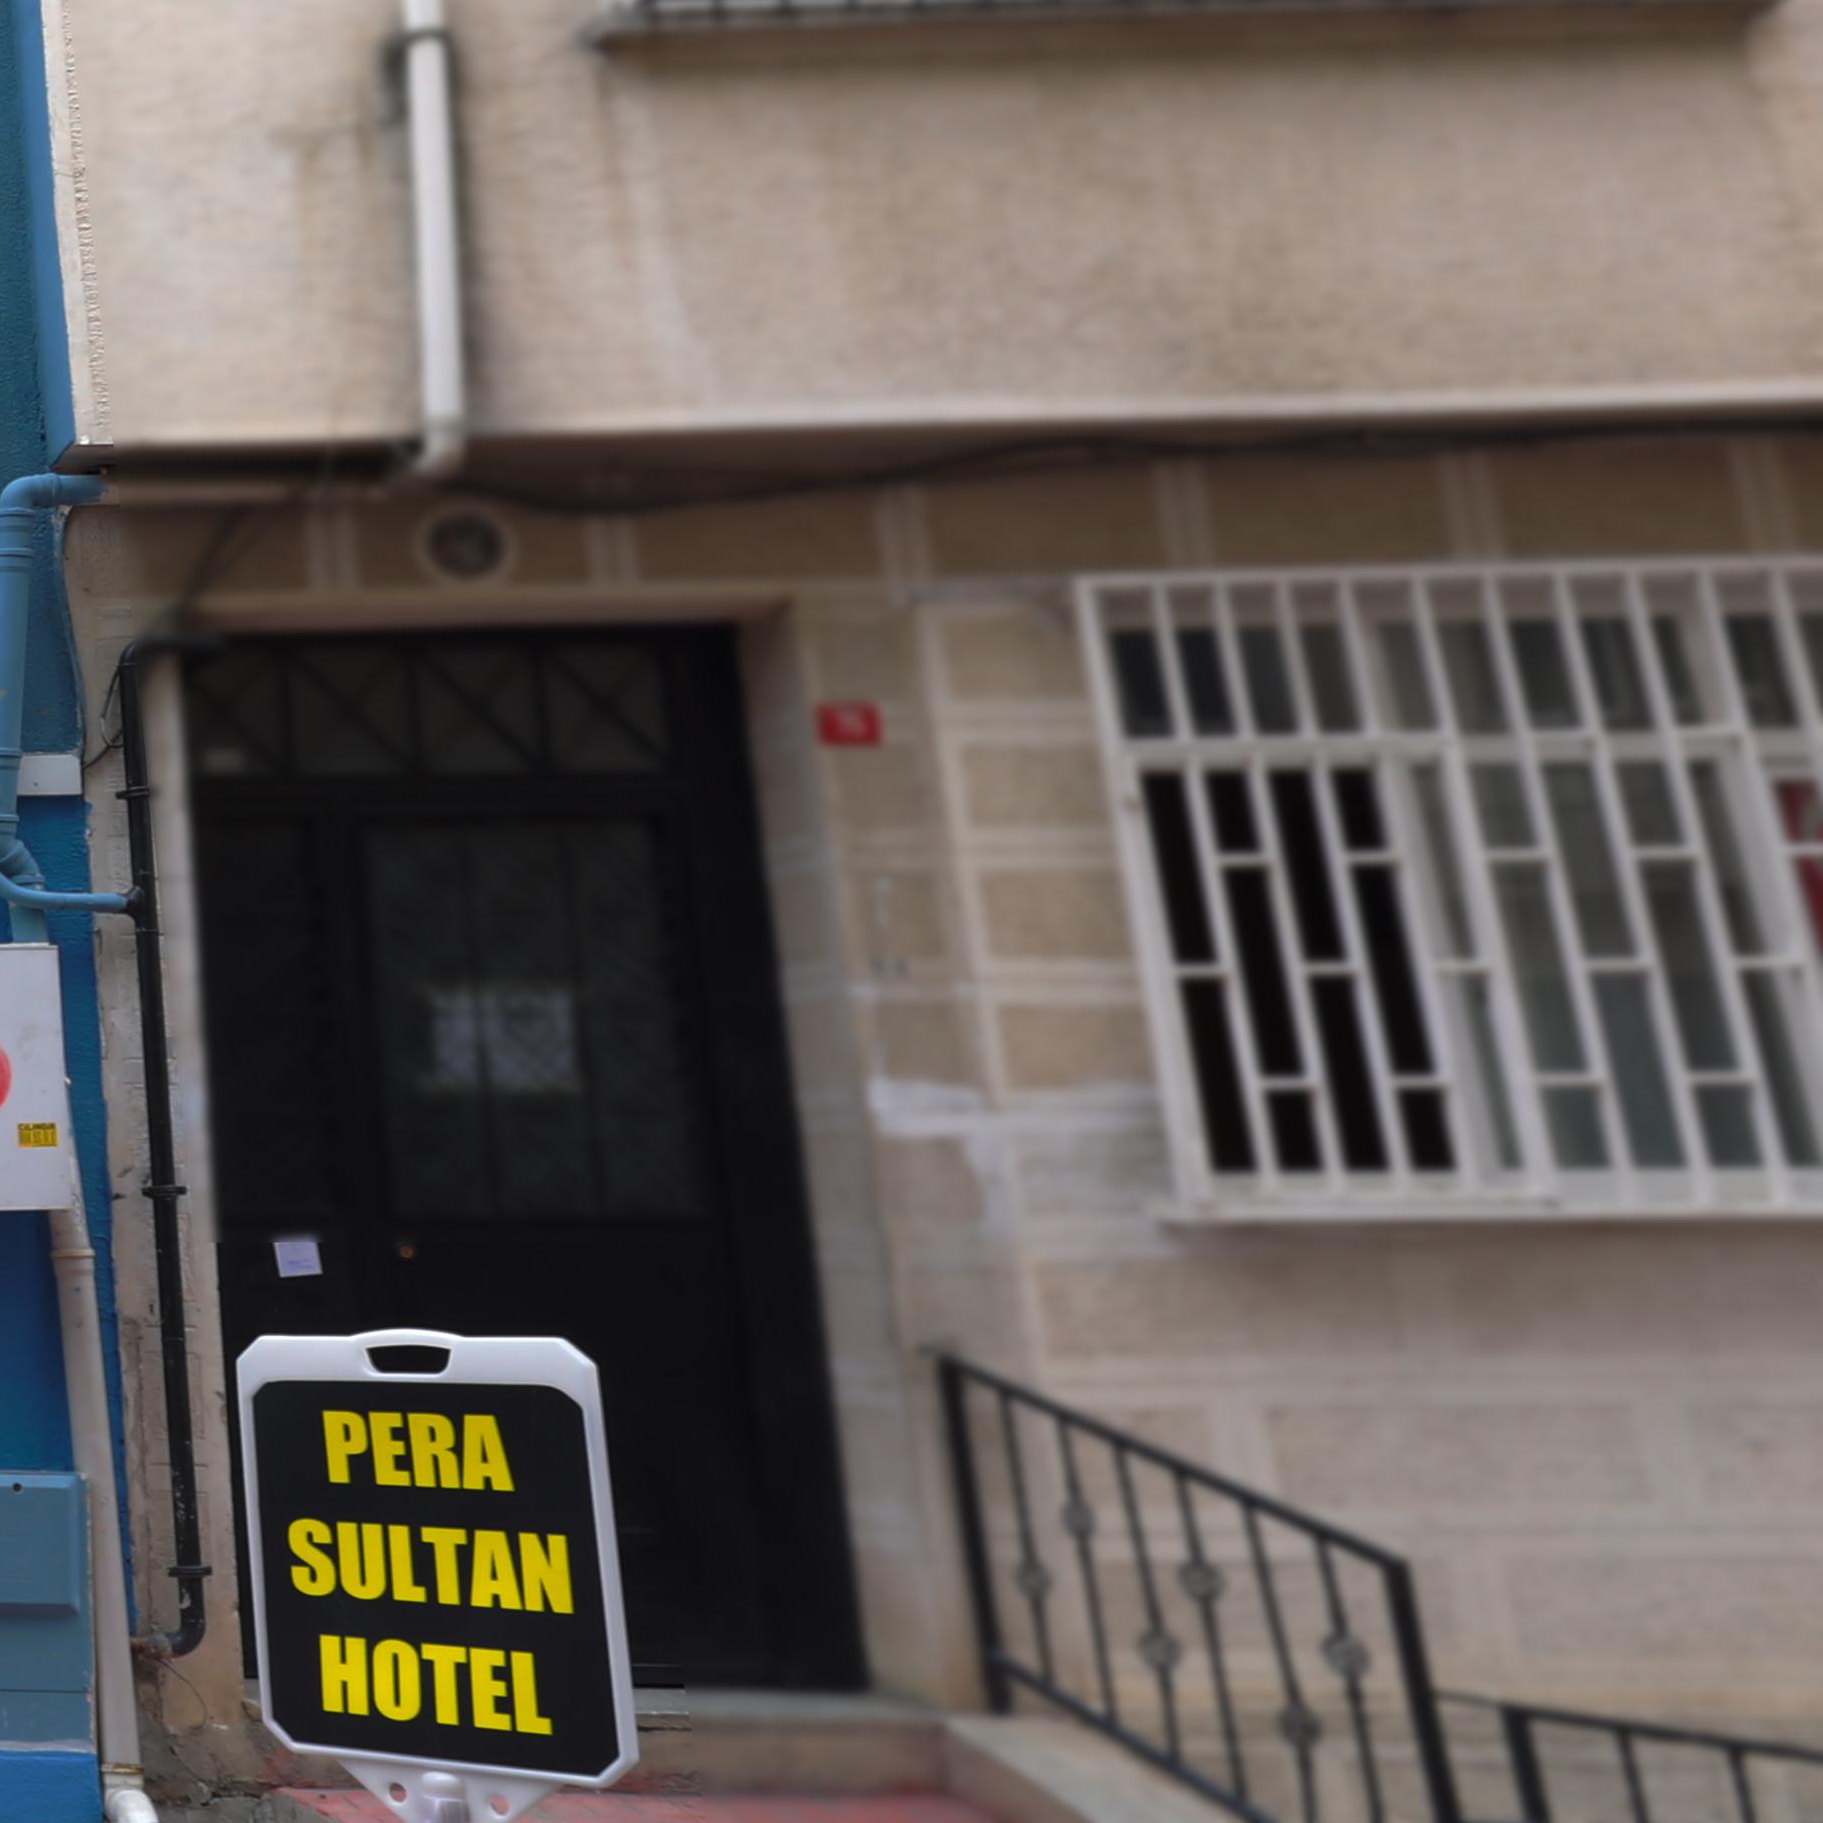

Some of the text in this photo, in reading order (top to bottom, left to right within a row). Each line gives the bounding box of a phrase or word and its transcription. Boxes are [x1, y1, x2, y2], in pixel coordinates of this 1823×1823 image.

[322, 1409, 515, 1493] PERA
[287, 1518, 574, 1615] SULTAN
[319, 1634, 553, 1736] HOTEL
